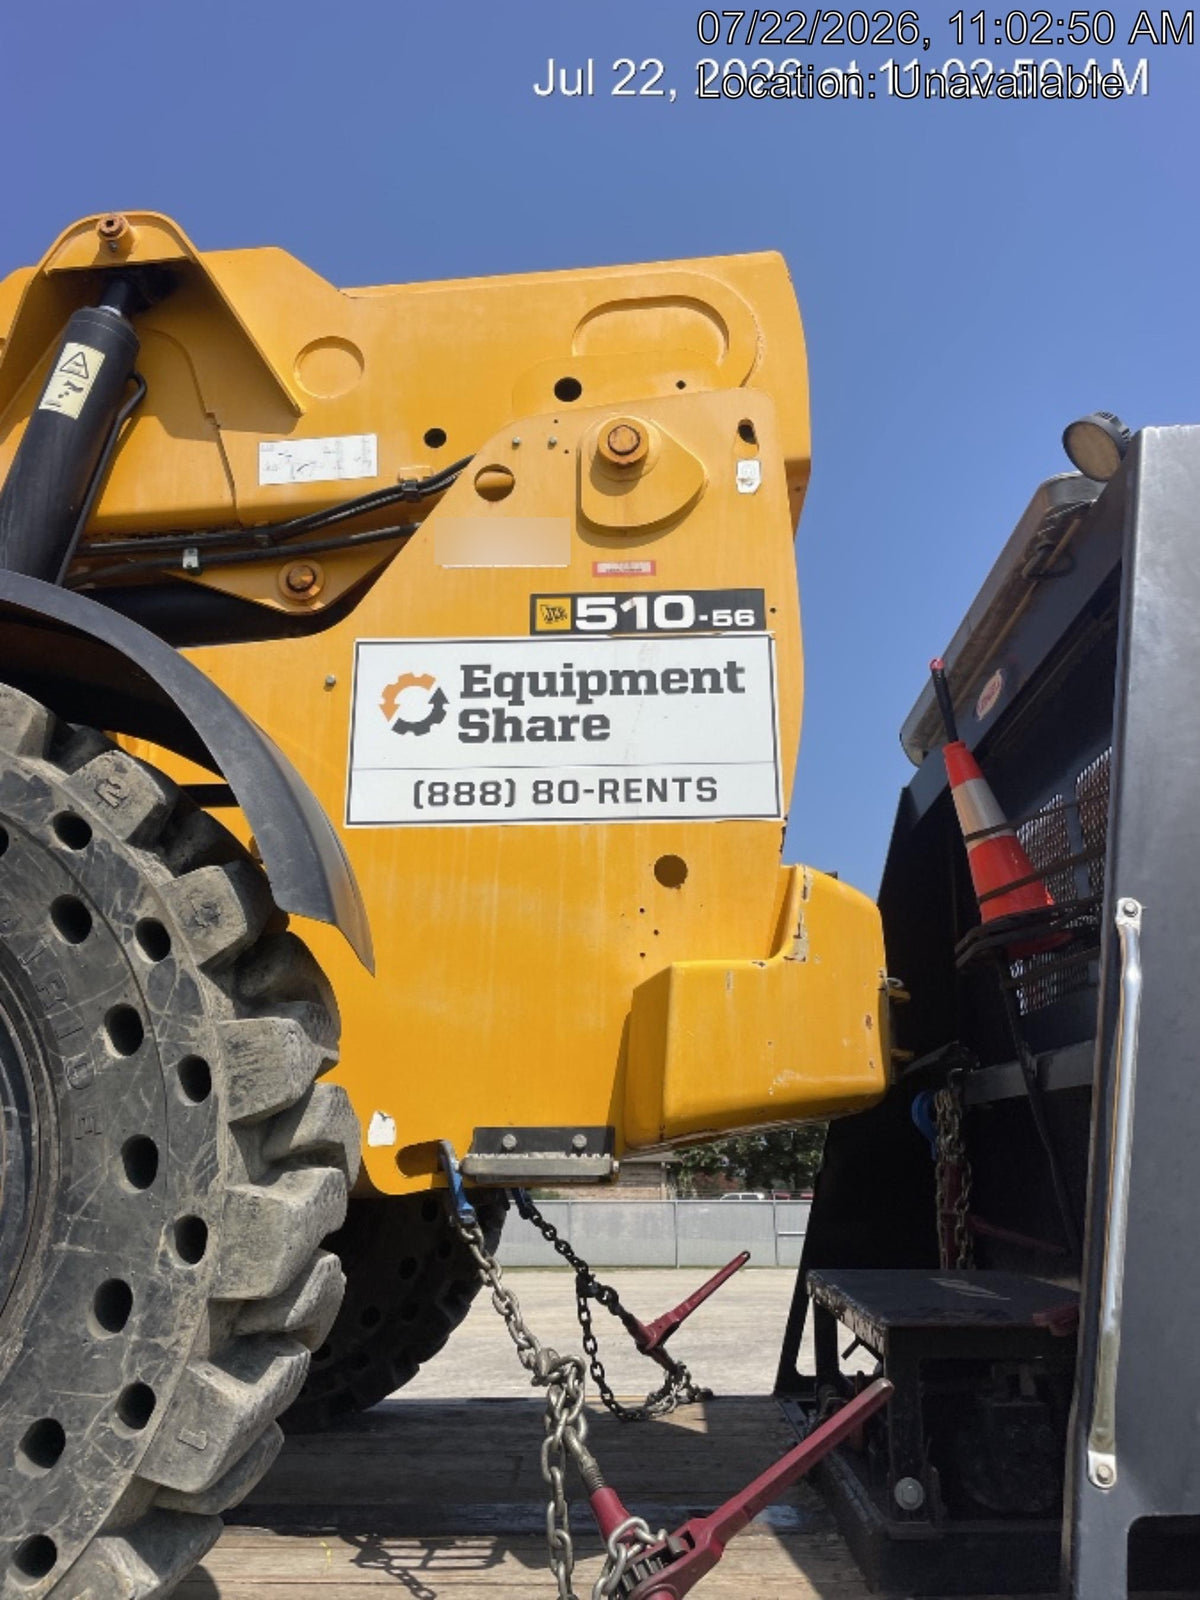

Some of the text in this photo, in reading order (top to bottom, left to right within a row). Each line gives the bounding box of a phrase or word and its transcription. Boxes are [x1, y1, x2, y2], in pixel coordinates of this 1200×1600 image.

[575, 594, 756, 630] 510-56
[459, 660, 746, 706] Equipment
[458, 707, 611, 744] Share
[413, 775, 719, 809] (888) 80-RENTS
